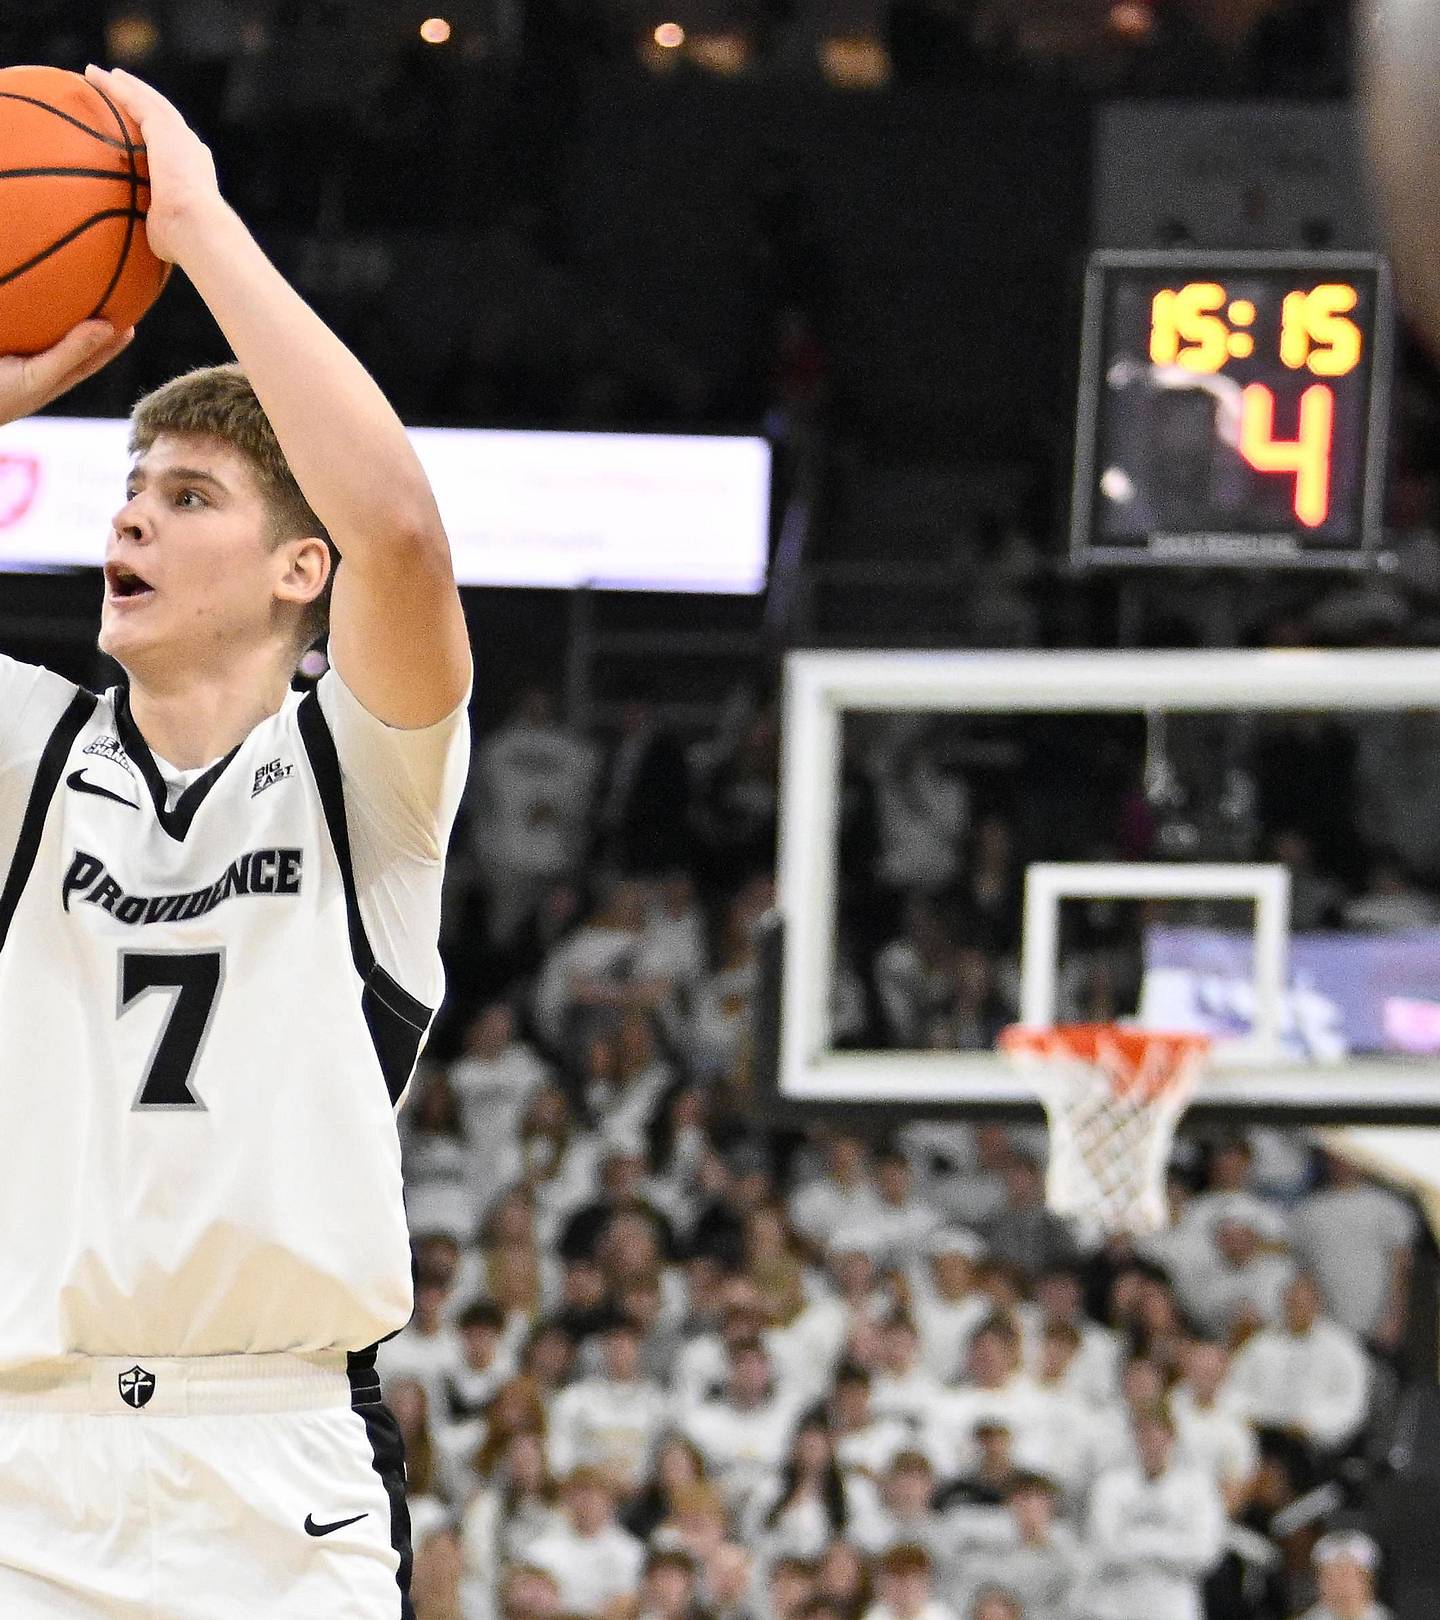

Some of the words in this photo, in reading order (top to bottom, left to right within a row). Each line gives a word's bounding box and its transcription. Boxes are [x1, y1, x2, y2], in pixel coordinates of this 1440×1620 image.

[1239, 382, 1334, 527] 4
[252, 764, 294, 793] EAST
[255, 758, 281, 780] BIG
[62, 848, 303, 925] PROVIDENCE
[115, 946, 227, 1112] 7
